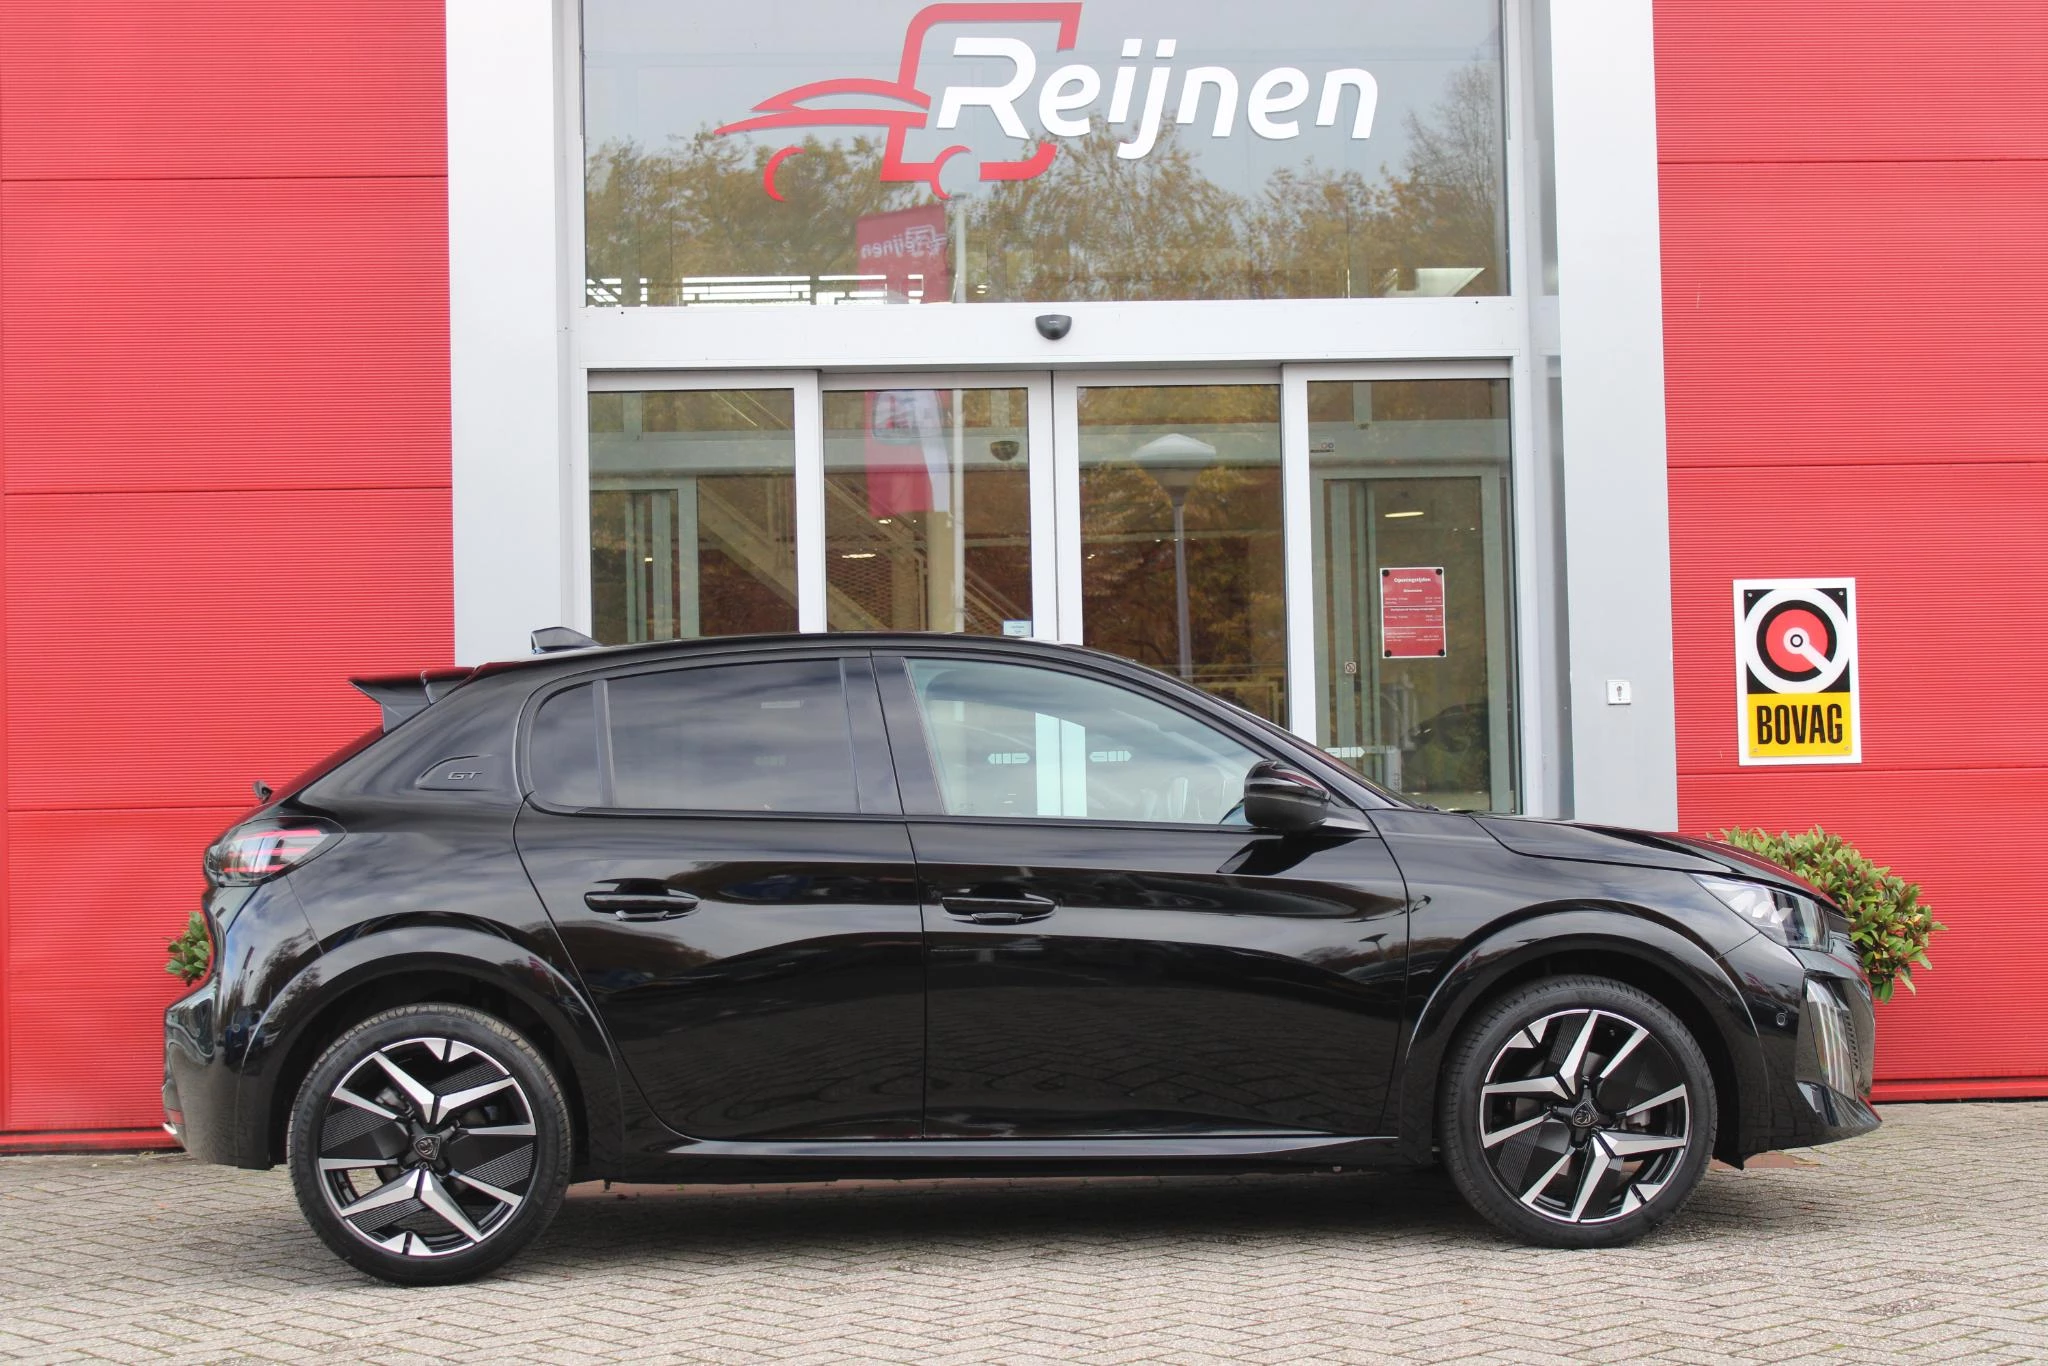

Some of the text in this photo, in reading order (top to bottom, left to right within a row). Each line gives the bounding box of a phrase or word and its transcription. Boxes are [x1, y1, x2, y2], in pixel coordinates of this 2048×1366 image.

[936, 37, 1378, 160] Reijnen
[1756, 703, 1843, 745] BOVAG
[447, 771, 482, 781] GT
